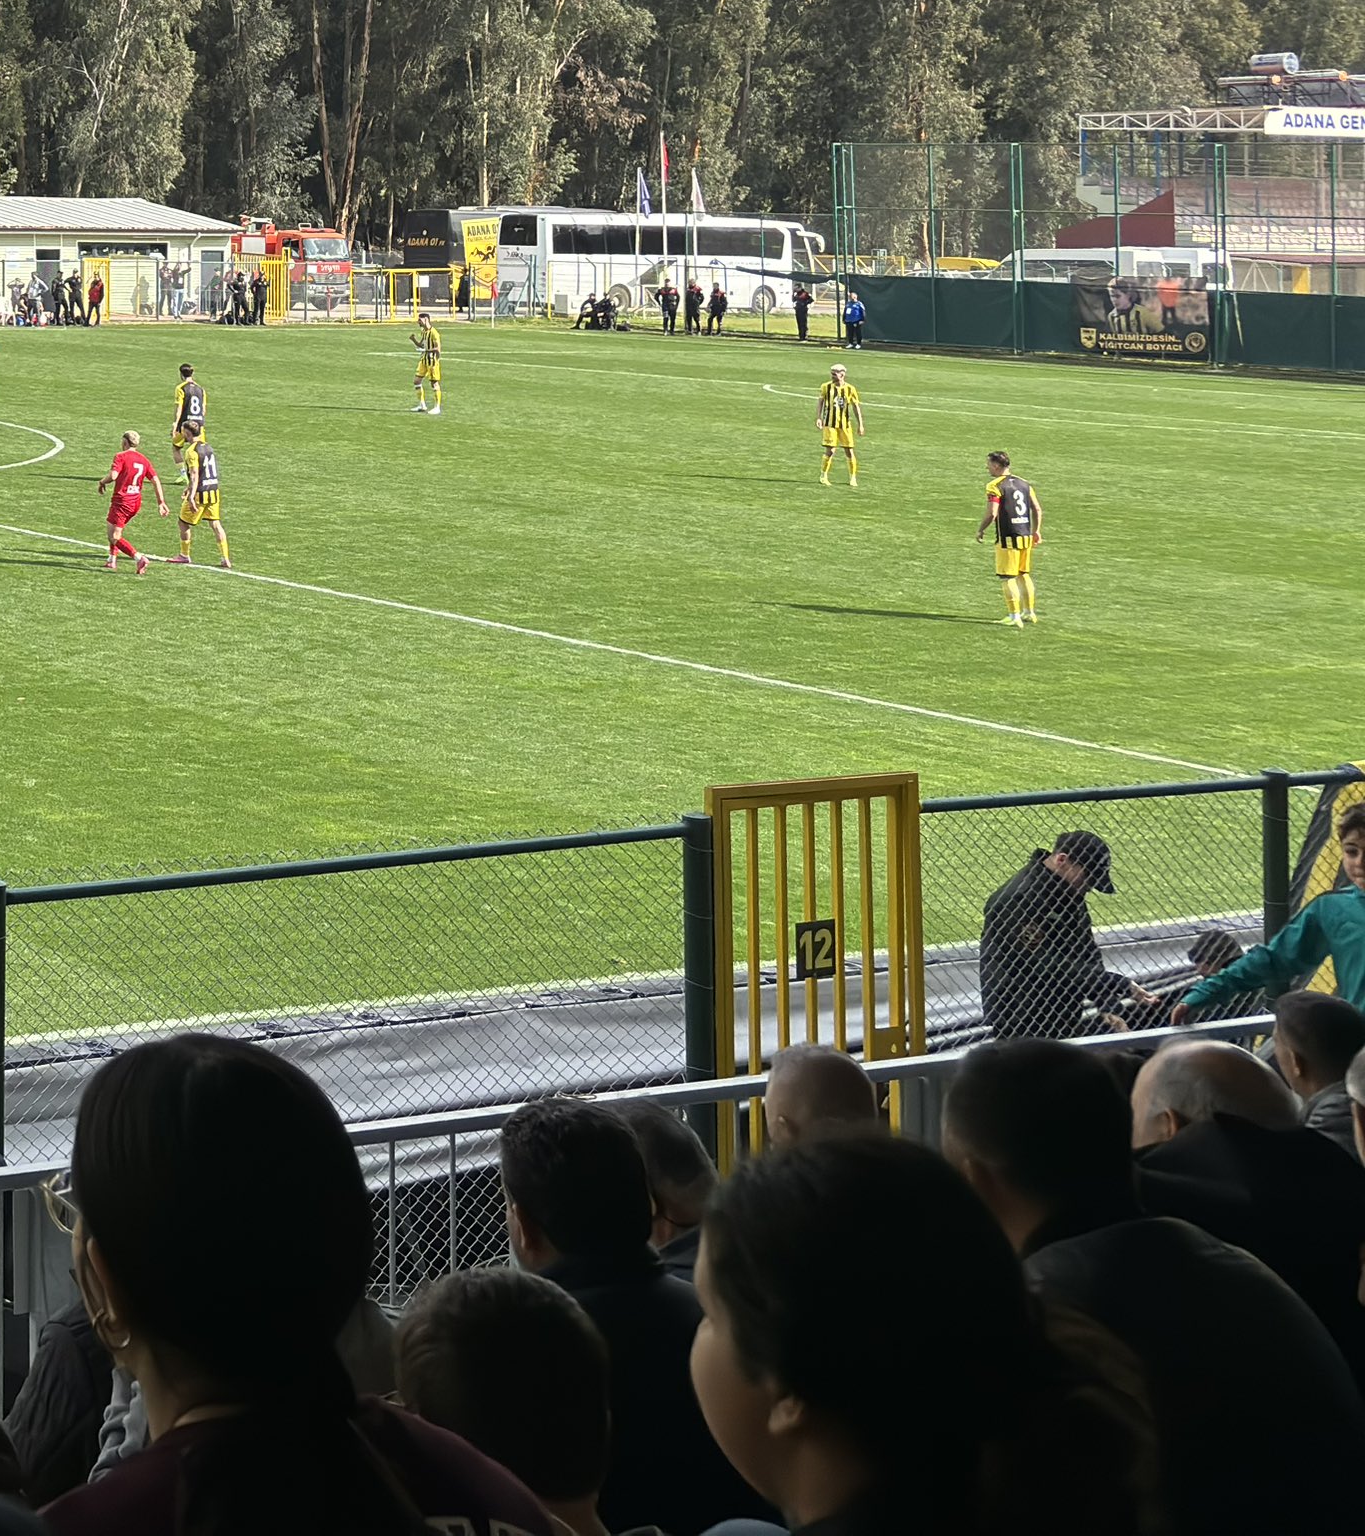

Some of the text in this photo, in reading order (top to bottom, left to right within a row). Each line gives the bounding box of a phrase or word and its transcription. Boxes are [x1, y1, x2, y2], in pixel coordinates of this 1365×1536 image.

[1283, 113, 1335, 129] ADANA
[467, 224, 490, 236] ADANA
[407, 237, 429, 247] ADANA
[190, 395, 201, 415] 8
[133, 462, 144, 486] 7
[203, 455, 218, 479] 11
[1013, 489, 1027, 515] 3
[799, 928, 833, 971] 12
